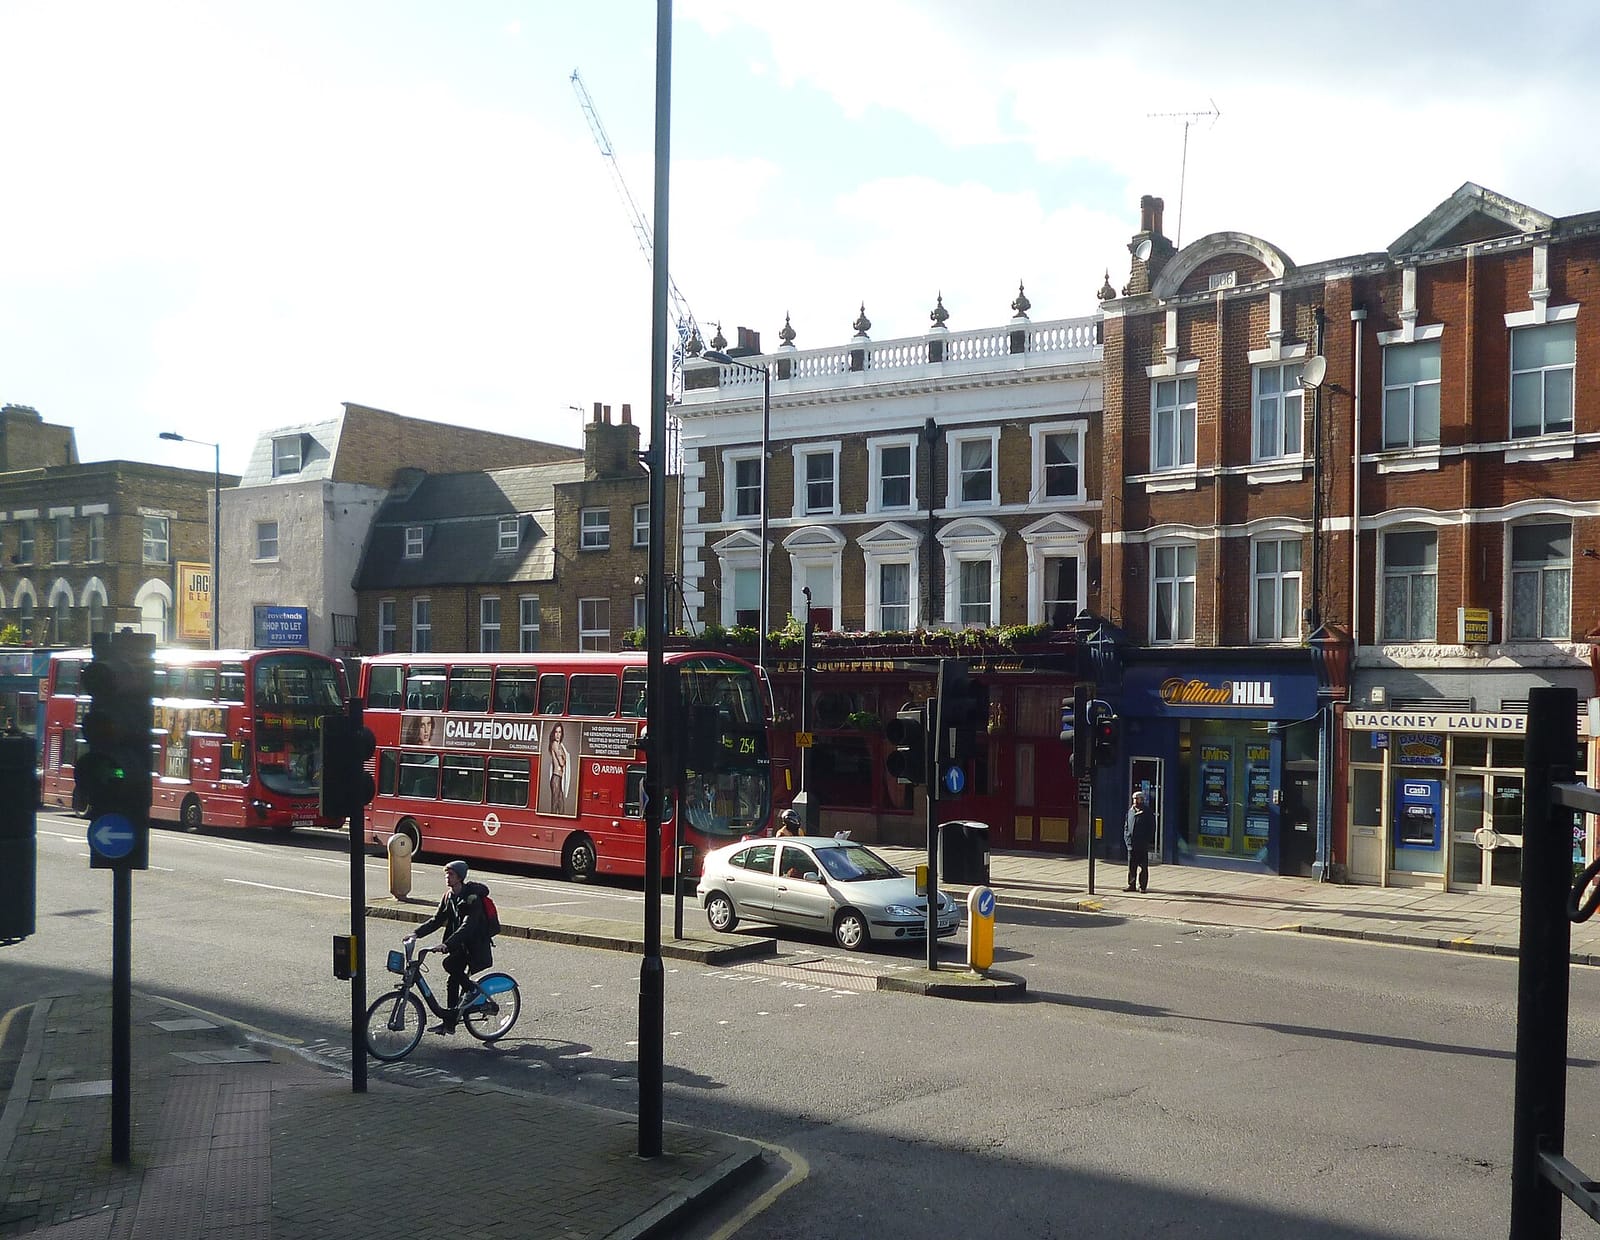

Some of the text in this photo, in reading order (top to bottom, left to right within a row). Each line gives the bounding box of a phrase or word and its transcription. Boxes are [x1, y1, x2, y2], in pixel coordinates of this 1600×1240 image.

[189, 573, 211, 592] JAC
[280, 621, 289, 631] TO
[290, 621, 302, 631] LET
[1159, 677, 1275, 705] William HILL
[1355, 714, 1437, 728] HACKNEY
[446, 720, 539, 742] CALZEDONIA
[740, 737, 755, 753] 254
[169, 757, 184, 777] MEN
[600, 764, 624, 774] ARRIVA
